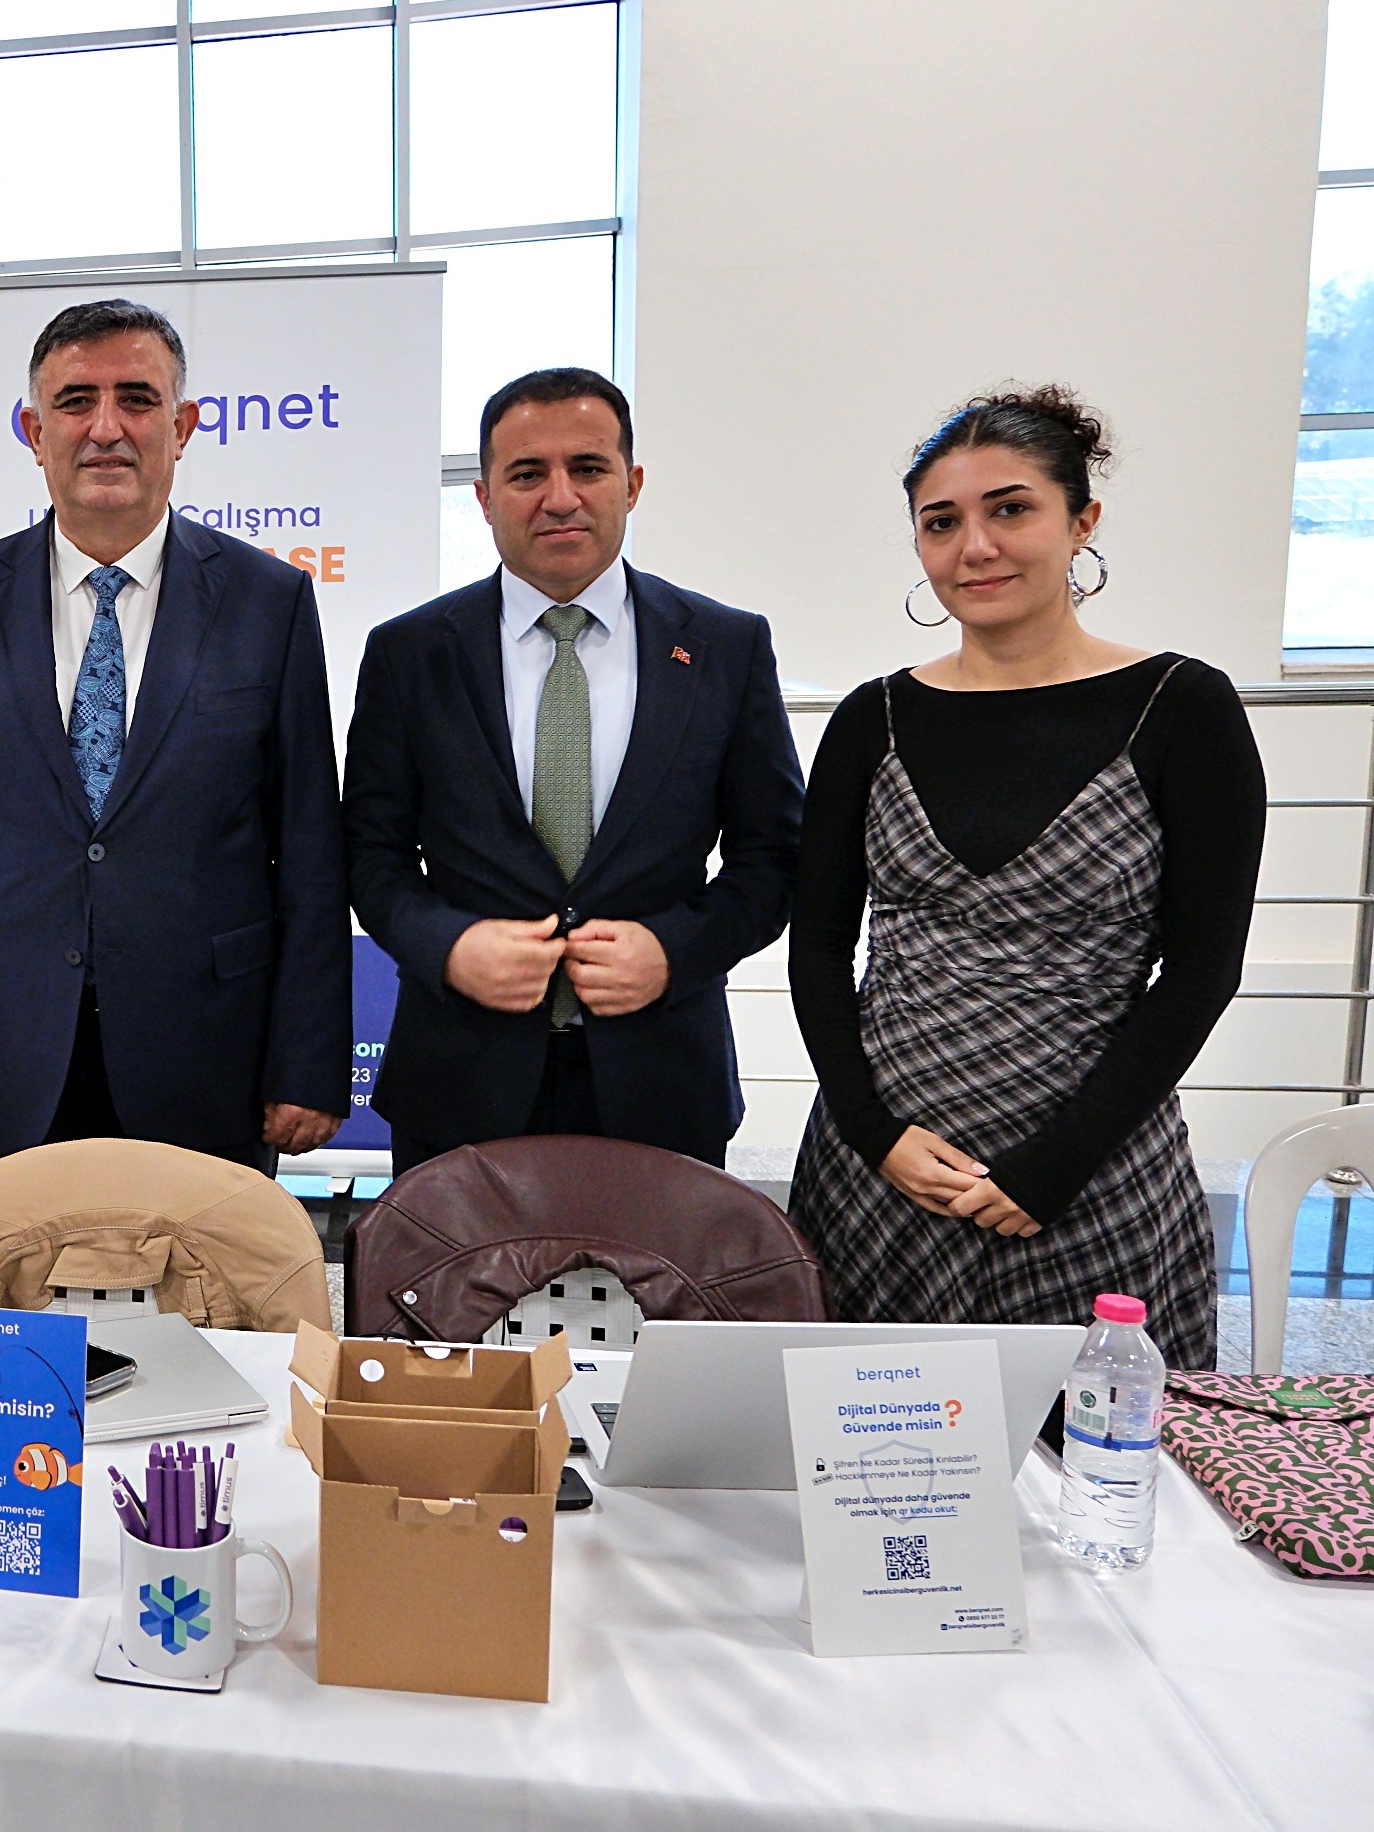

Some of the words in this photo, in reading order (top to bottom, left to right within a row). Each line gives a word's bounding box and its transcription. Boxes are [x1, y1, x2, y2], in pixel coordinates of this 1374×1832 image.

[197, 384, 340, 446] qnet
[856, 1366, 921, 1383] berqnet
[838, 1404, 877, 1419] Dijital
[879, 1401, 941, 1416] Dünyada
[842, 1421, 903, 1434] Güvende
[905, 1418, 943, 1431] misin
[222, 1476, 233, 1504] timus
[834, 1496, 861, 1507] Dijital
[862, 1495, 903, 1505] dünyada
[904, 1493, 929, 1502] daha
[930, 1491, 971, 1503] güvende
[26, 1507, 45, 1518] çöz:
[850, 1508, 878, 1517] olmak
